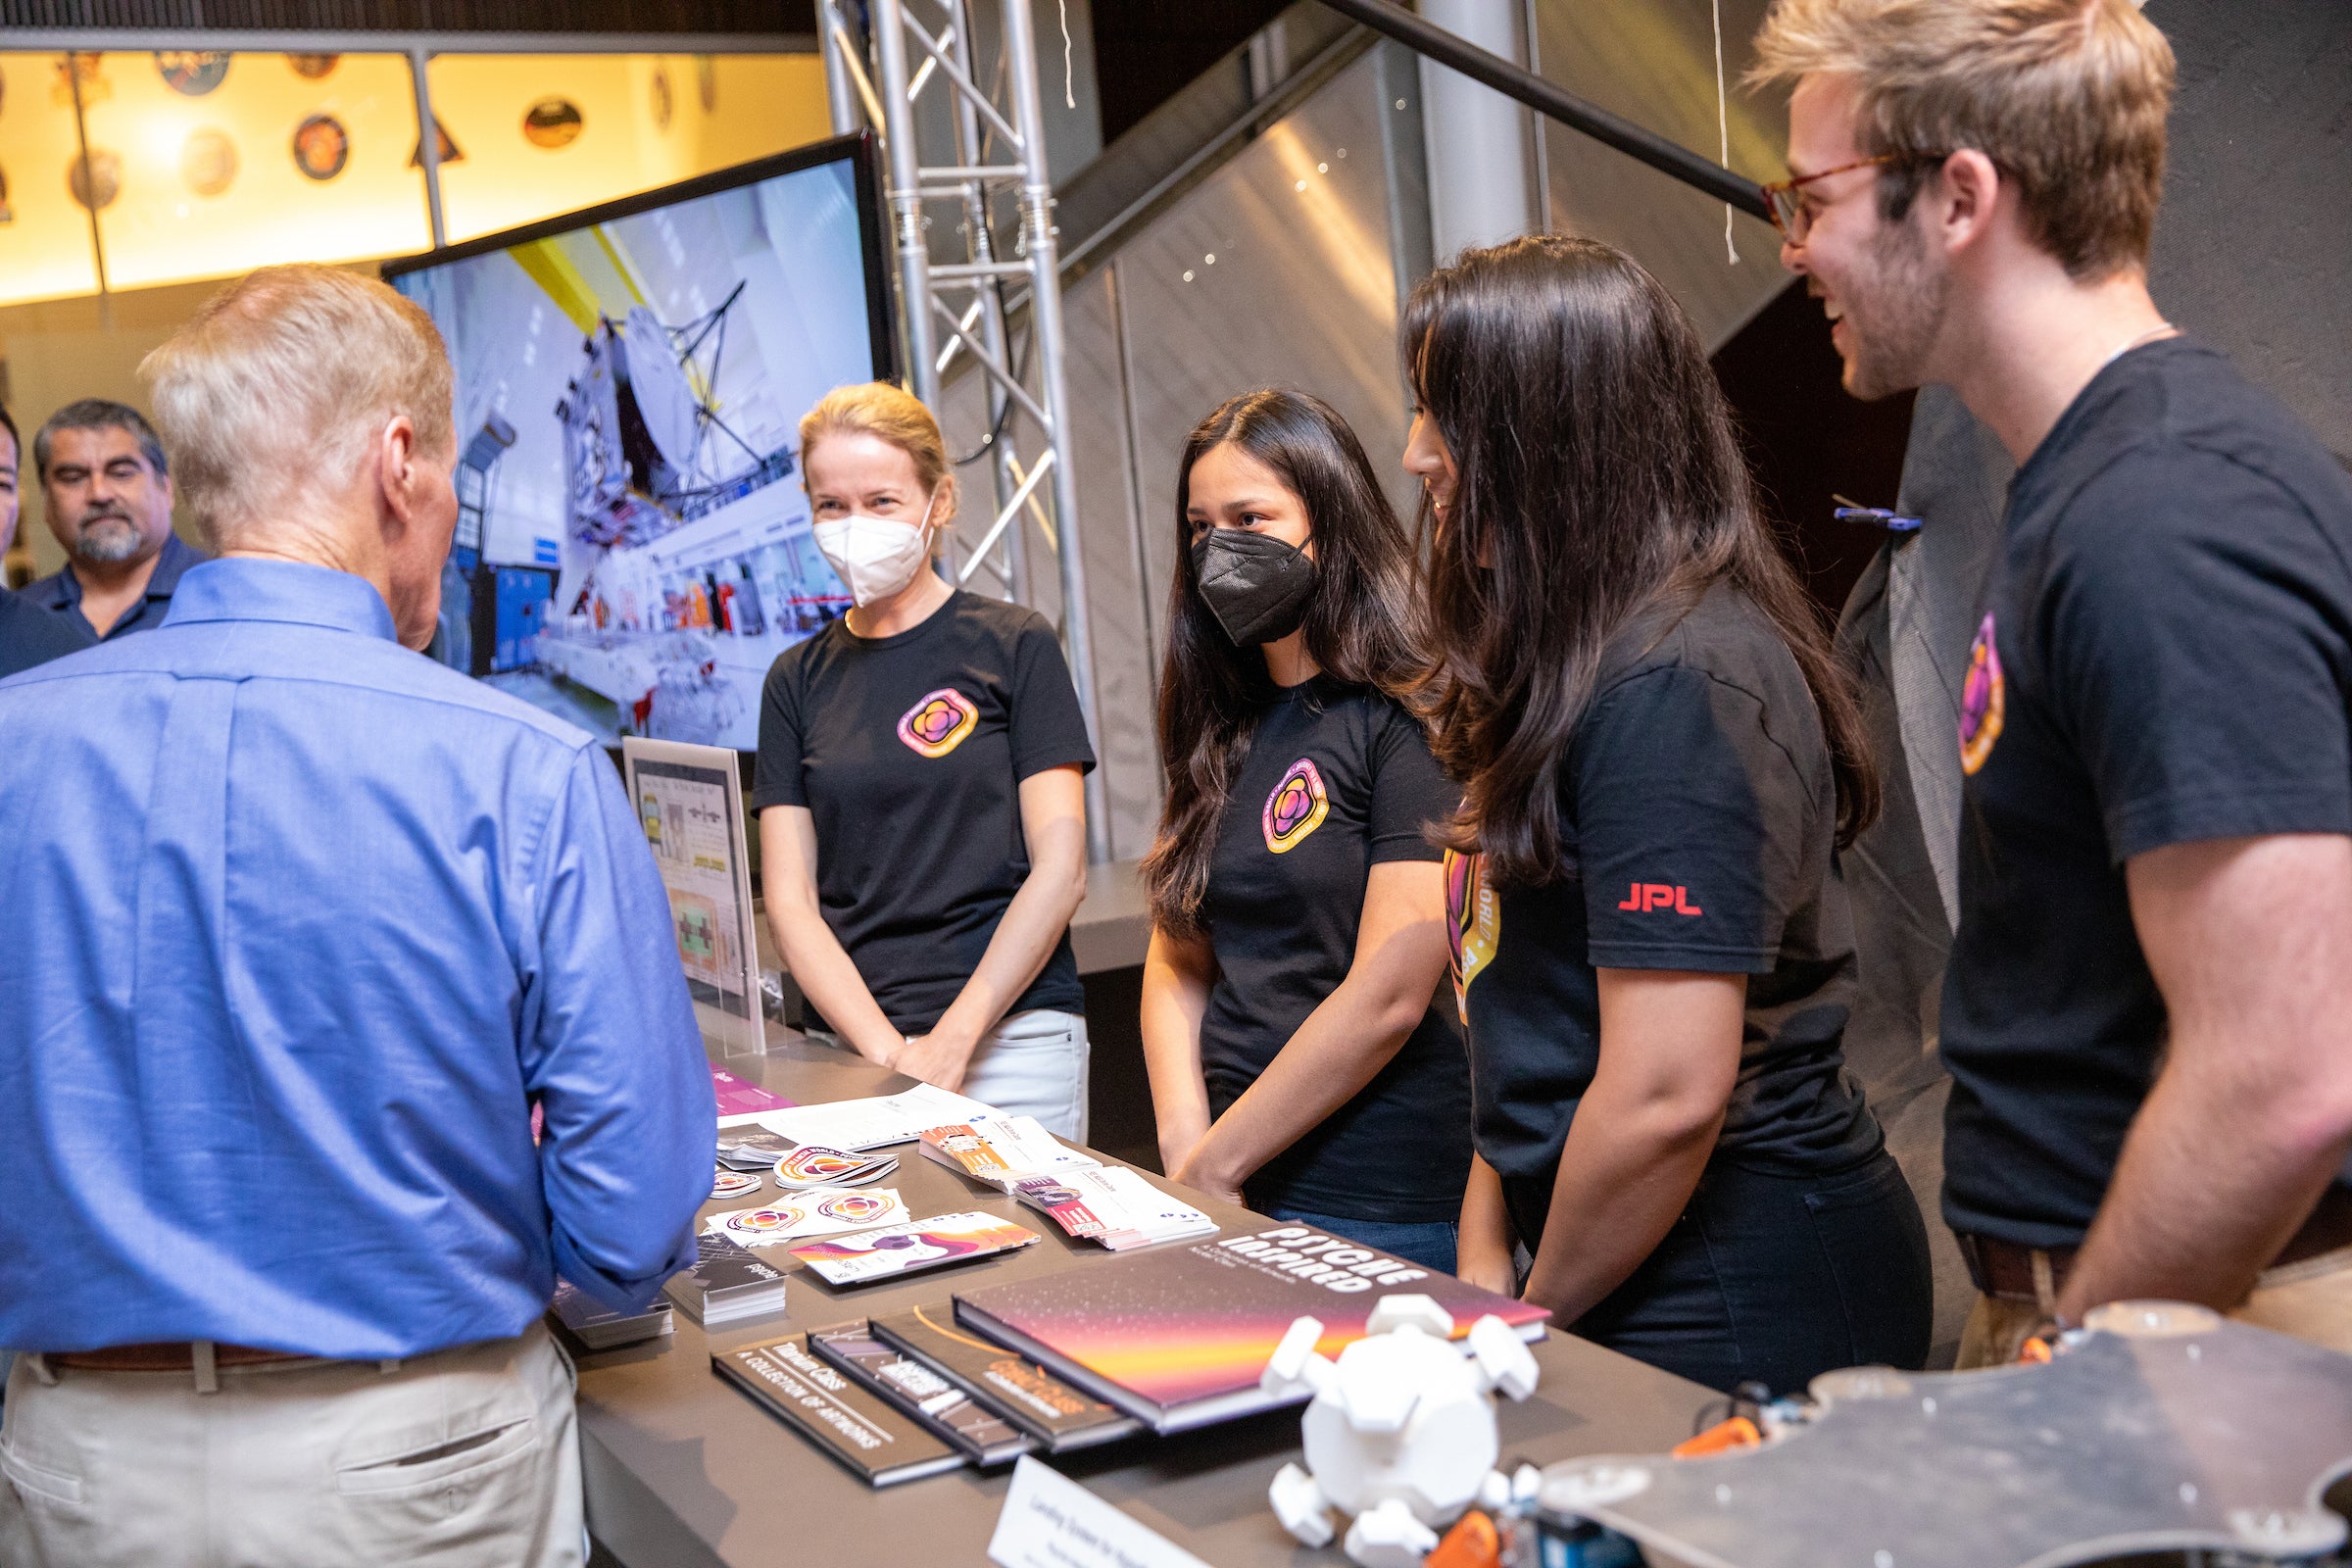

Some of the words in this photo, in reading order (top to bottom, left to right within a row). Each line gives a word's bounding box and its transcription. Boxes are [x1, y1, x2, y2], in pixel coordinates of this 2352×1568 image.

[1618, 882, 1703, 916] JPL
[1217, 1235, 1373, 1293] INSPIRED
[1257, 1227, 1429, 1286] PSYCHE
[772, 1341, 820, 1372] Titanium
[809, 1367, 848, 1392] Class
[736, 1350, 754, 1360] A
[745, 1356, 809, 1399] COLLECTION
[800, 1396, 826, 1408] OF
[815, 1406, 882, 1450] ARTWORKS
